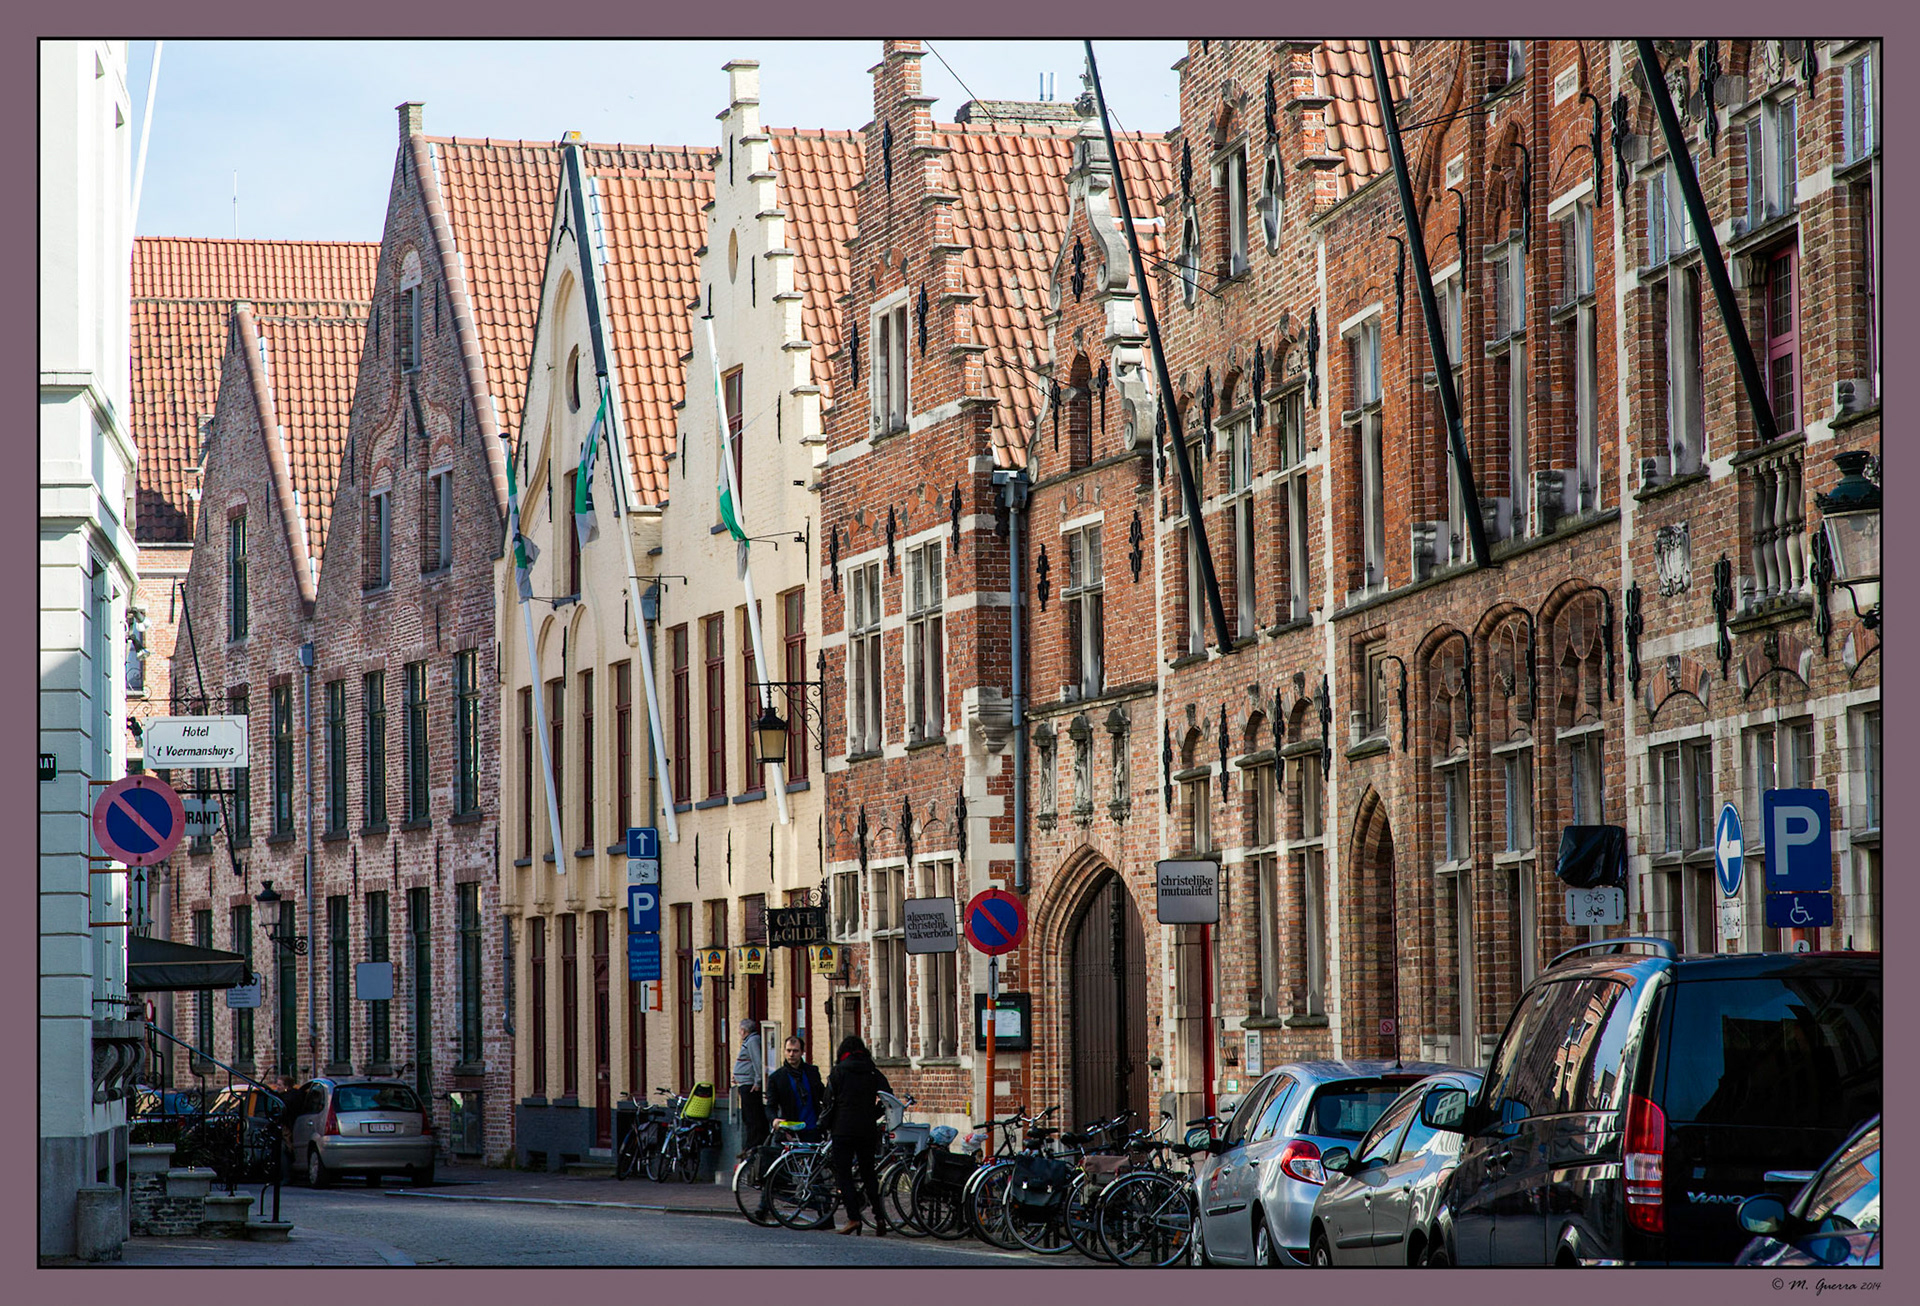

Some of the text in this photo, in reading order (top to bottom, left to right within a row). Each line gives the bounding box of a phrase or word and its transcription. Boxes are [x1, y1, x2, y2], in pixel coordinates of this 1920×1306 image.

[182, 725, 210, 737] Hotel
[166, 744, 235, 759] Voermanshuys
[185, 810, 219, 825] RANT
[1773, 805, 1821, 876] P
[1160, 875, 1214, 887] christelijke
[1161, 885, 1213, 897] mutualiteit
[632, 892, 655, 925] P
[906, 912, 945, 923] algemeen
[907, 919, 949, 931] christelijk
[781, 926, 824, 942] GILDE
[908, 928, 954, 940] vakverbond
[747, 962, 761, 971] Leffe
[819, 961, 834, 970] Leffe
